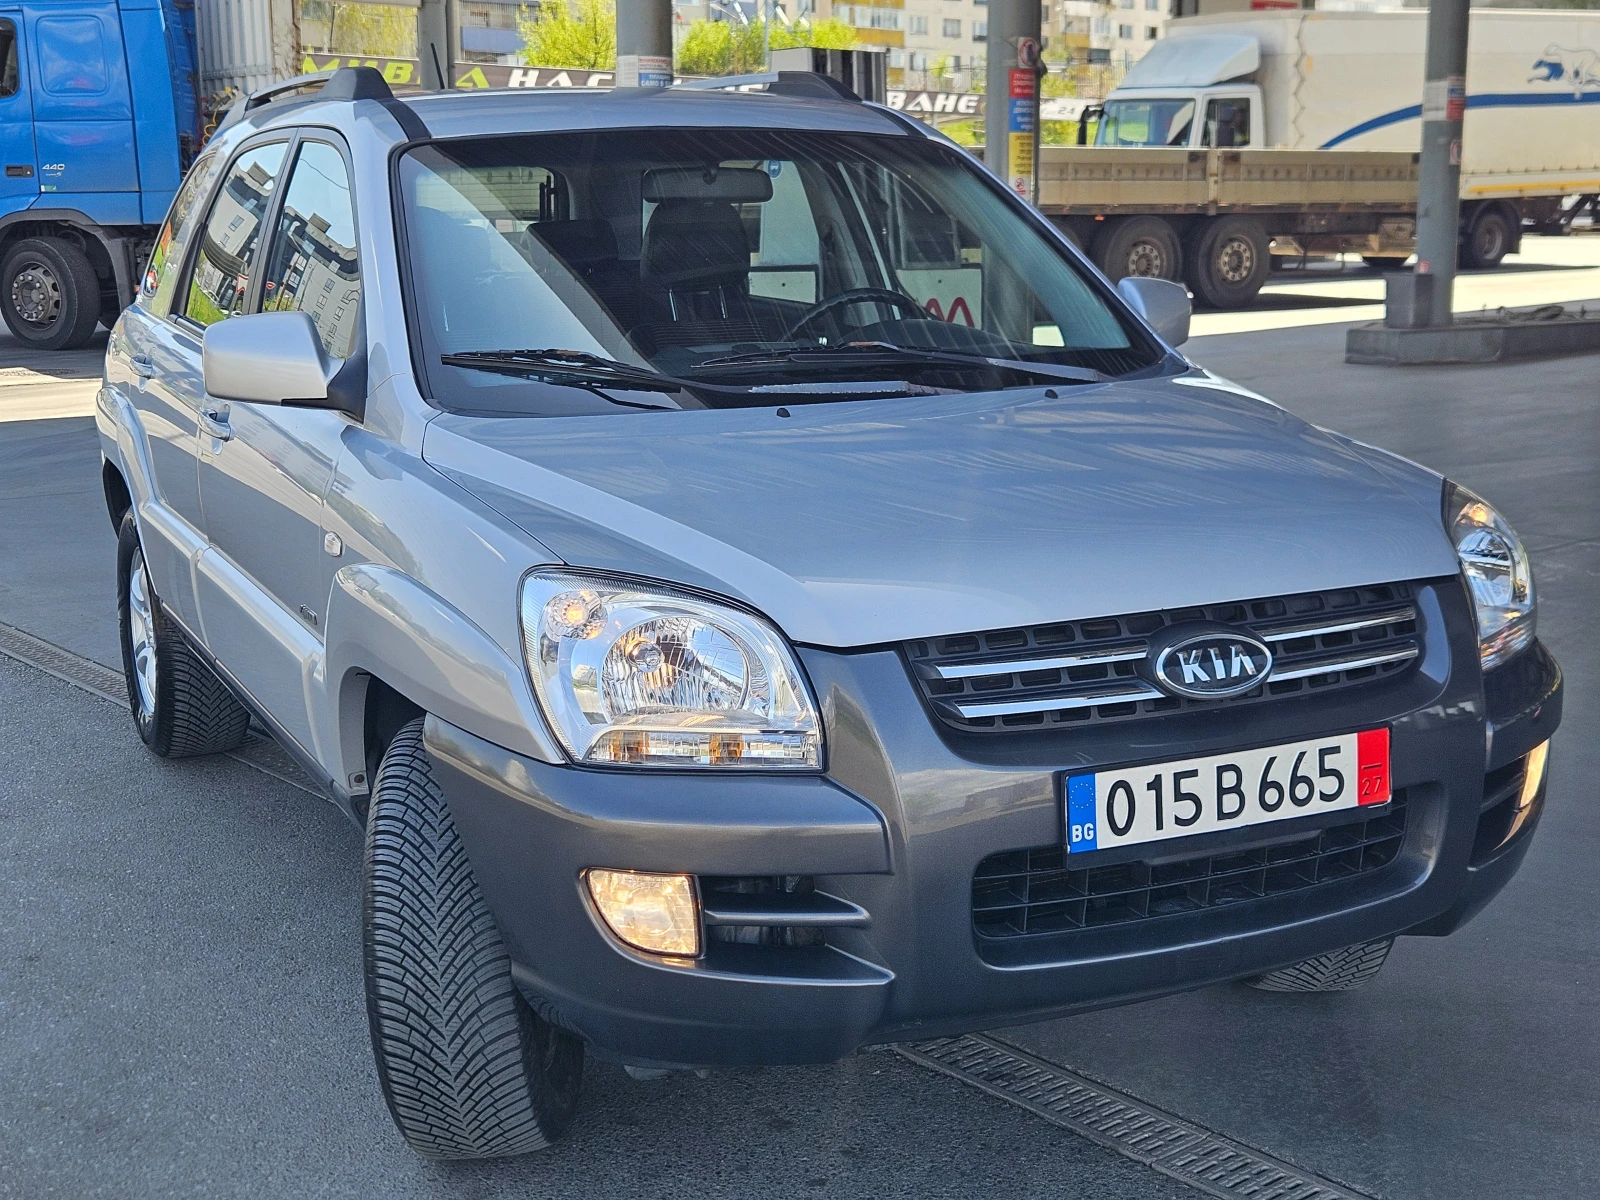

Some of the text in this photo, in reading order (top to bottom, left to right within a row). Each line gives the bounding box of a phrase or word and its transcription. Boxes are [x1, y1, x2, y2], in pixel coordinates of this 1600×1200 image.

[1177, 644, 1257, 684] KIA
[1361, 775, 1382, 796] 27
[1071, 822, 1095, 843] BG
